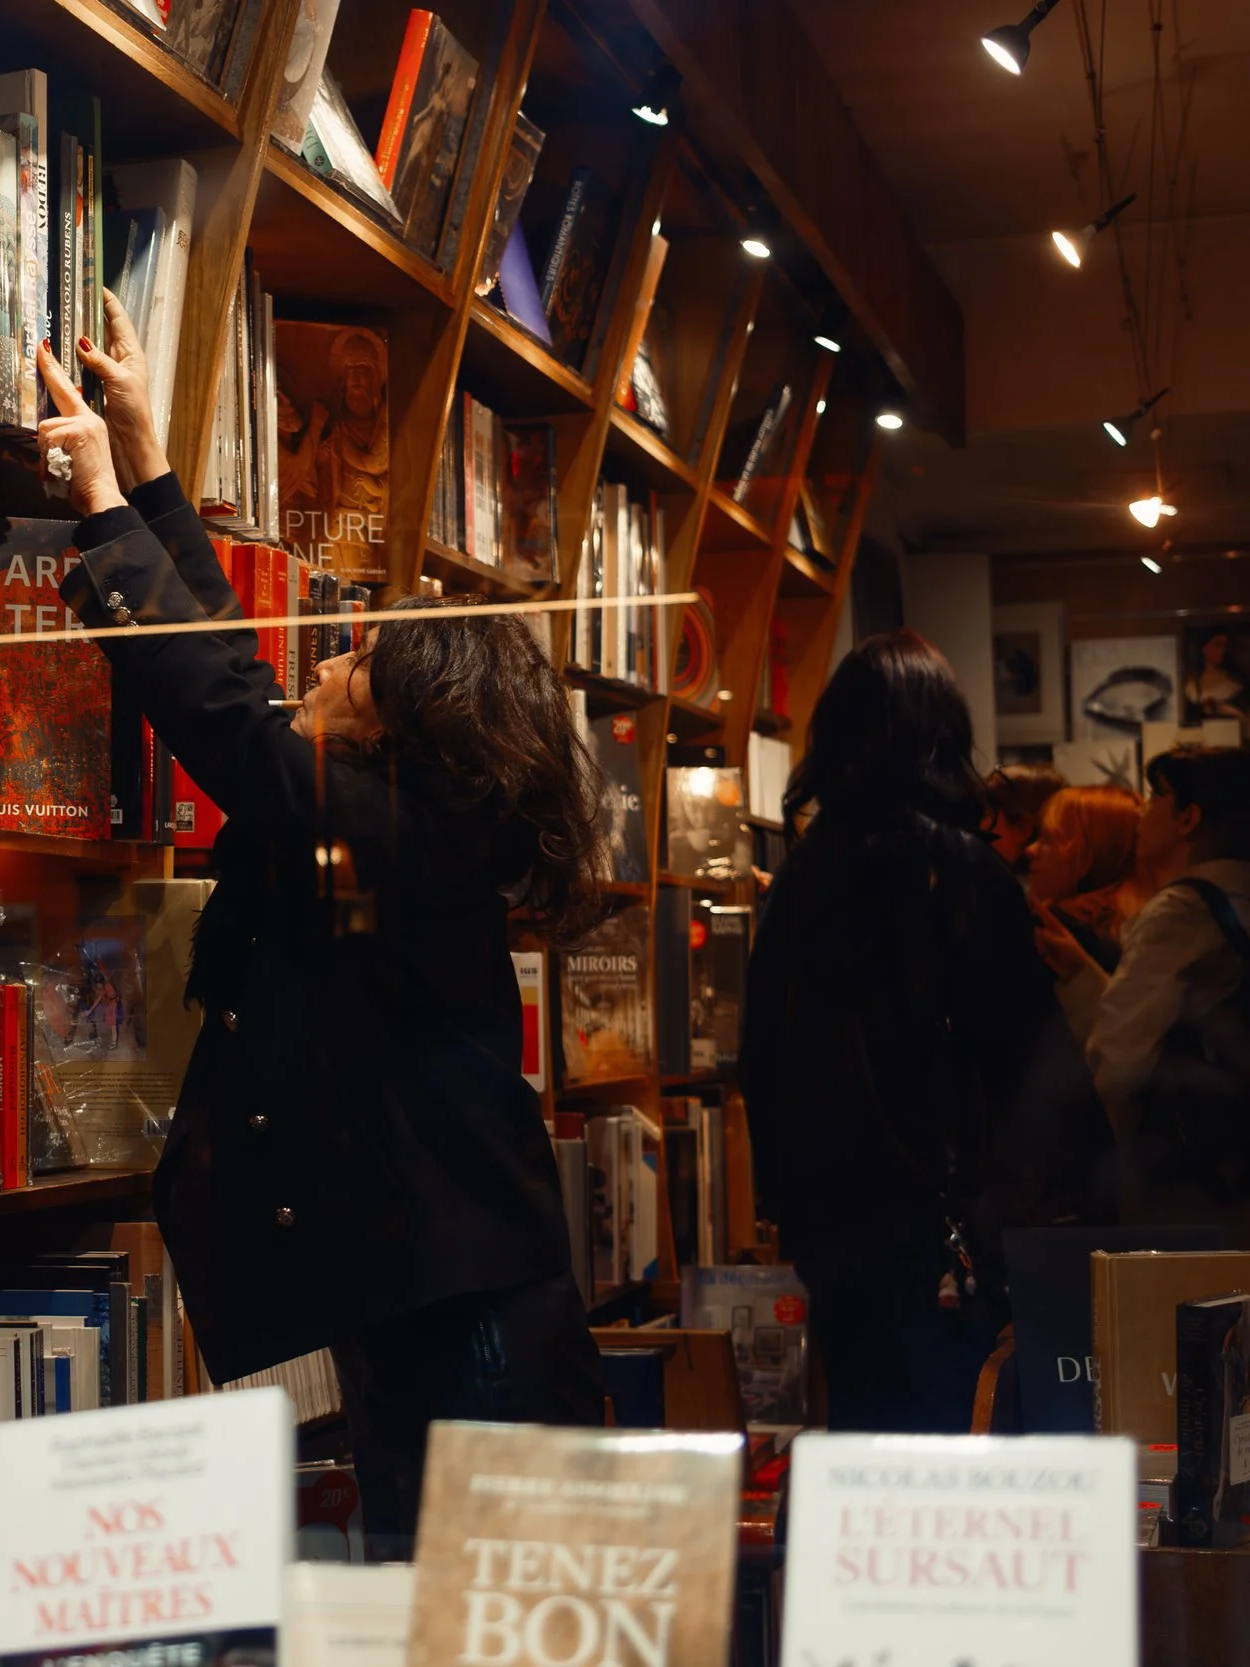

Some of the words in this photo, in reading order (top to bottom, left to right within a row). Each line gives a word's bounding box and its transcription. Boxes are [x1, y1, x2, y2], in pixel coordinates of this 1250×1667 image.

[62, 211, 71, 268] RUBENS
[62, 272, 71, 321] PAOLO
[22, 299, 39, 382] Martial
[25, 802, 89, 819] VUITTON
[567, 955, 638, 972] MIROIRS
[86, 1497, 166, 1540] NOS
[838, 1500, 1084, 1545] L'ÉTERNEL
[10, 1534, 240, 1595] NOUVEAUX
[463, 1537, 681, 1600] TENEZ
[833, 1545, 1090, 1595] SURSAUT
[35, 1583, 214, 1637] MAÎTRES
[459, 1590, 680, 1667] BON
